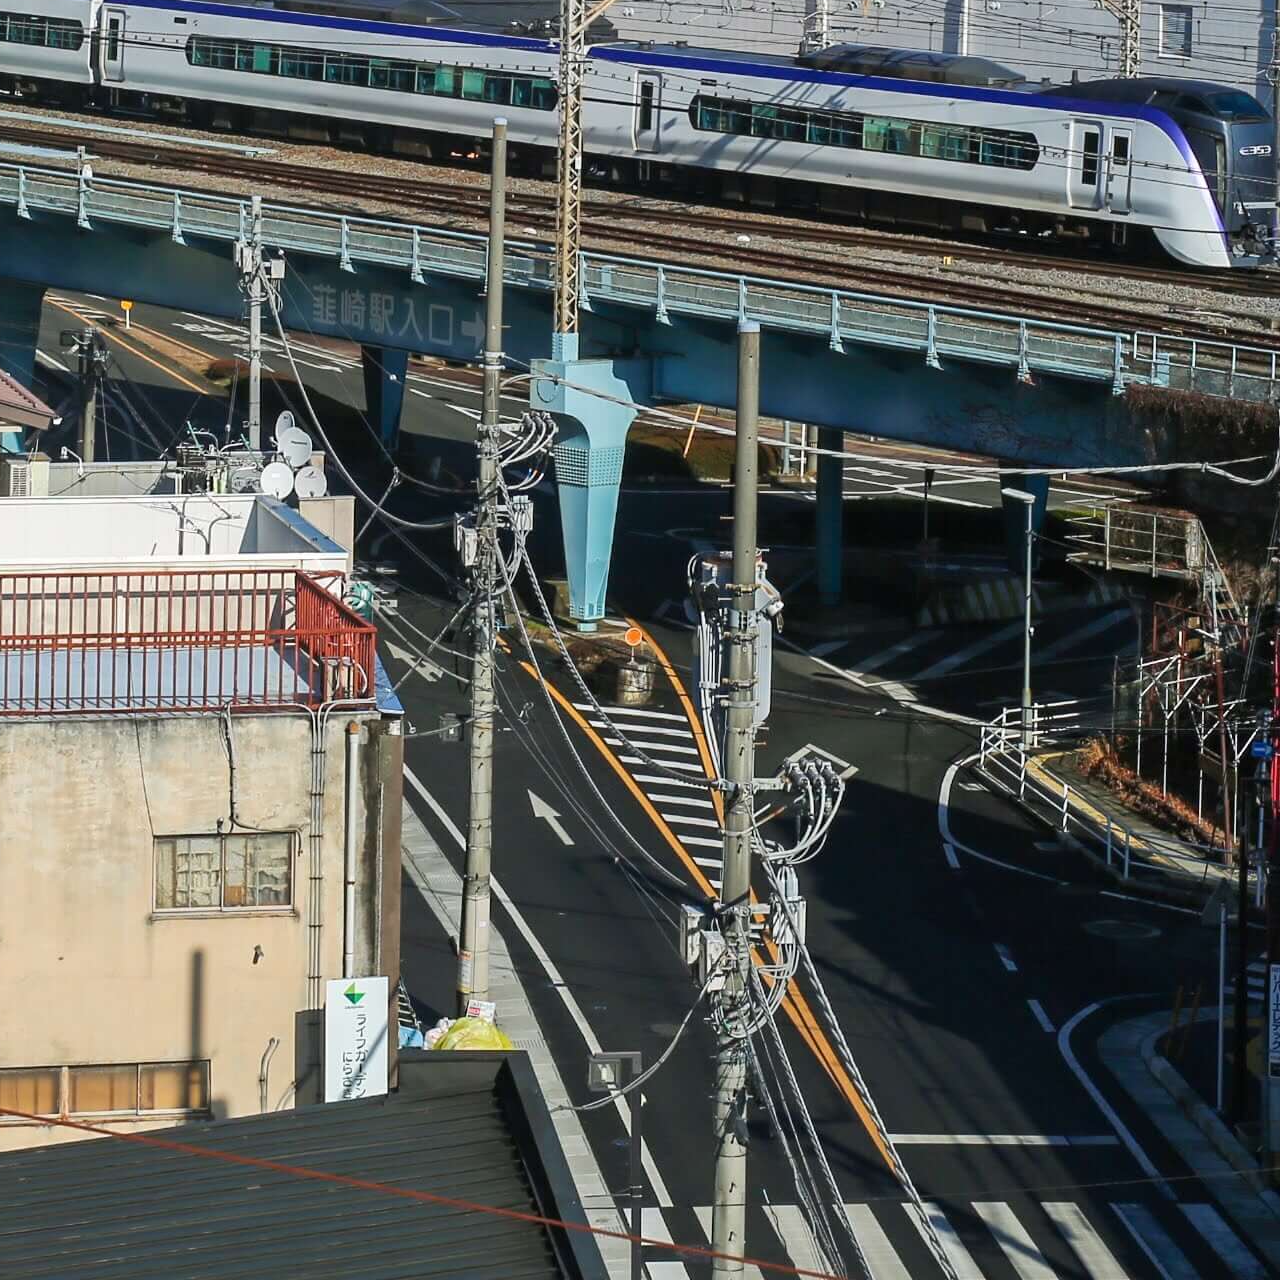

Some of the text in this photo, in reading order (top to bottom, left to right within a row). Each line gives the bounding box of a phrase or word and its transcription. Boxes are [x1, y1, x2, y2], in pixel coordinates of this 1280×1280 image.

[1239, 145, 1272, 156] E353
[312, 285, 454, 345] 韮崎駅入口
[355, 1013, 368, 1099] ライフガーデン
